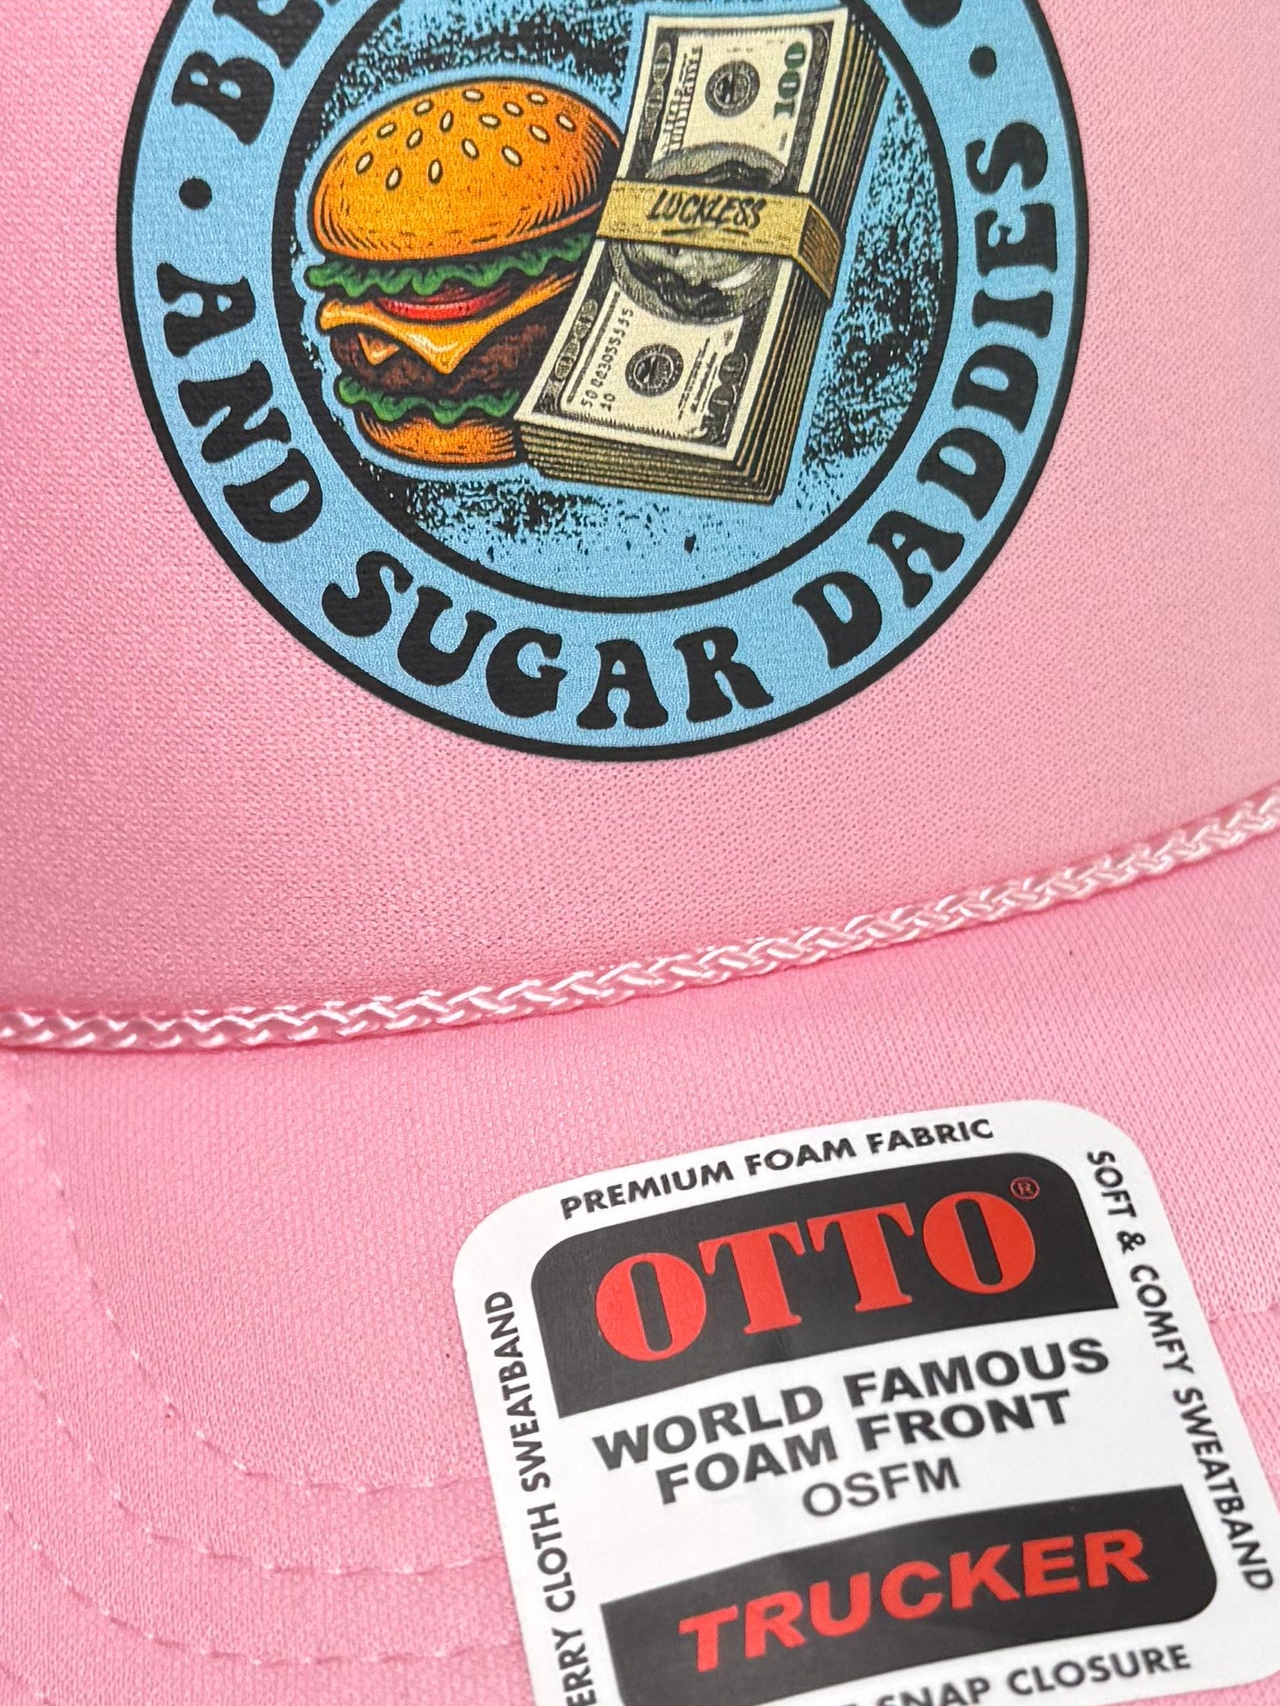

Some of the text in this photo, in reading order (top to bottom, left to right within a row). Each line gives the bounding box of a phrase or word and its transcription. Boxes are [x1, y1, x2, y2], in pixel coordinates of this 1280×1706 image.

[645, 189, 767, 230] LUCKLESS
[157, 122, 1057, 730] AND SUGAR DADDIES
[561, 1120, 993, 1219] PREMIUM FOAM FABRIC
[486, 1292, 550, 1491] SWEATBAND
[593, 1339, 1108, 1469] WORLD FAMOUS
[1088, 1152, 1273, 1589] SOFT & COMFY SWEATBAND
[657, 1390, 1069, 1504] FOAM FRONT
[804, 1458, 959, 1516] OSFM
[528, 1504, 575, 1612] CLOTH
[679, 1531, 1147, 1672] TRUCKER
[1009, 1645, 1190, 1694] CLOSURE
